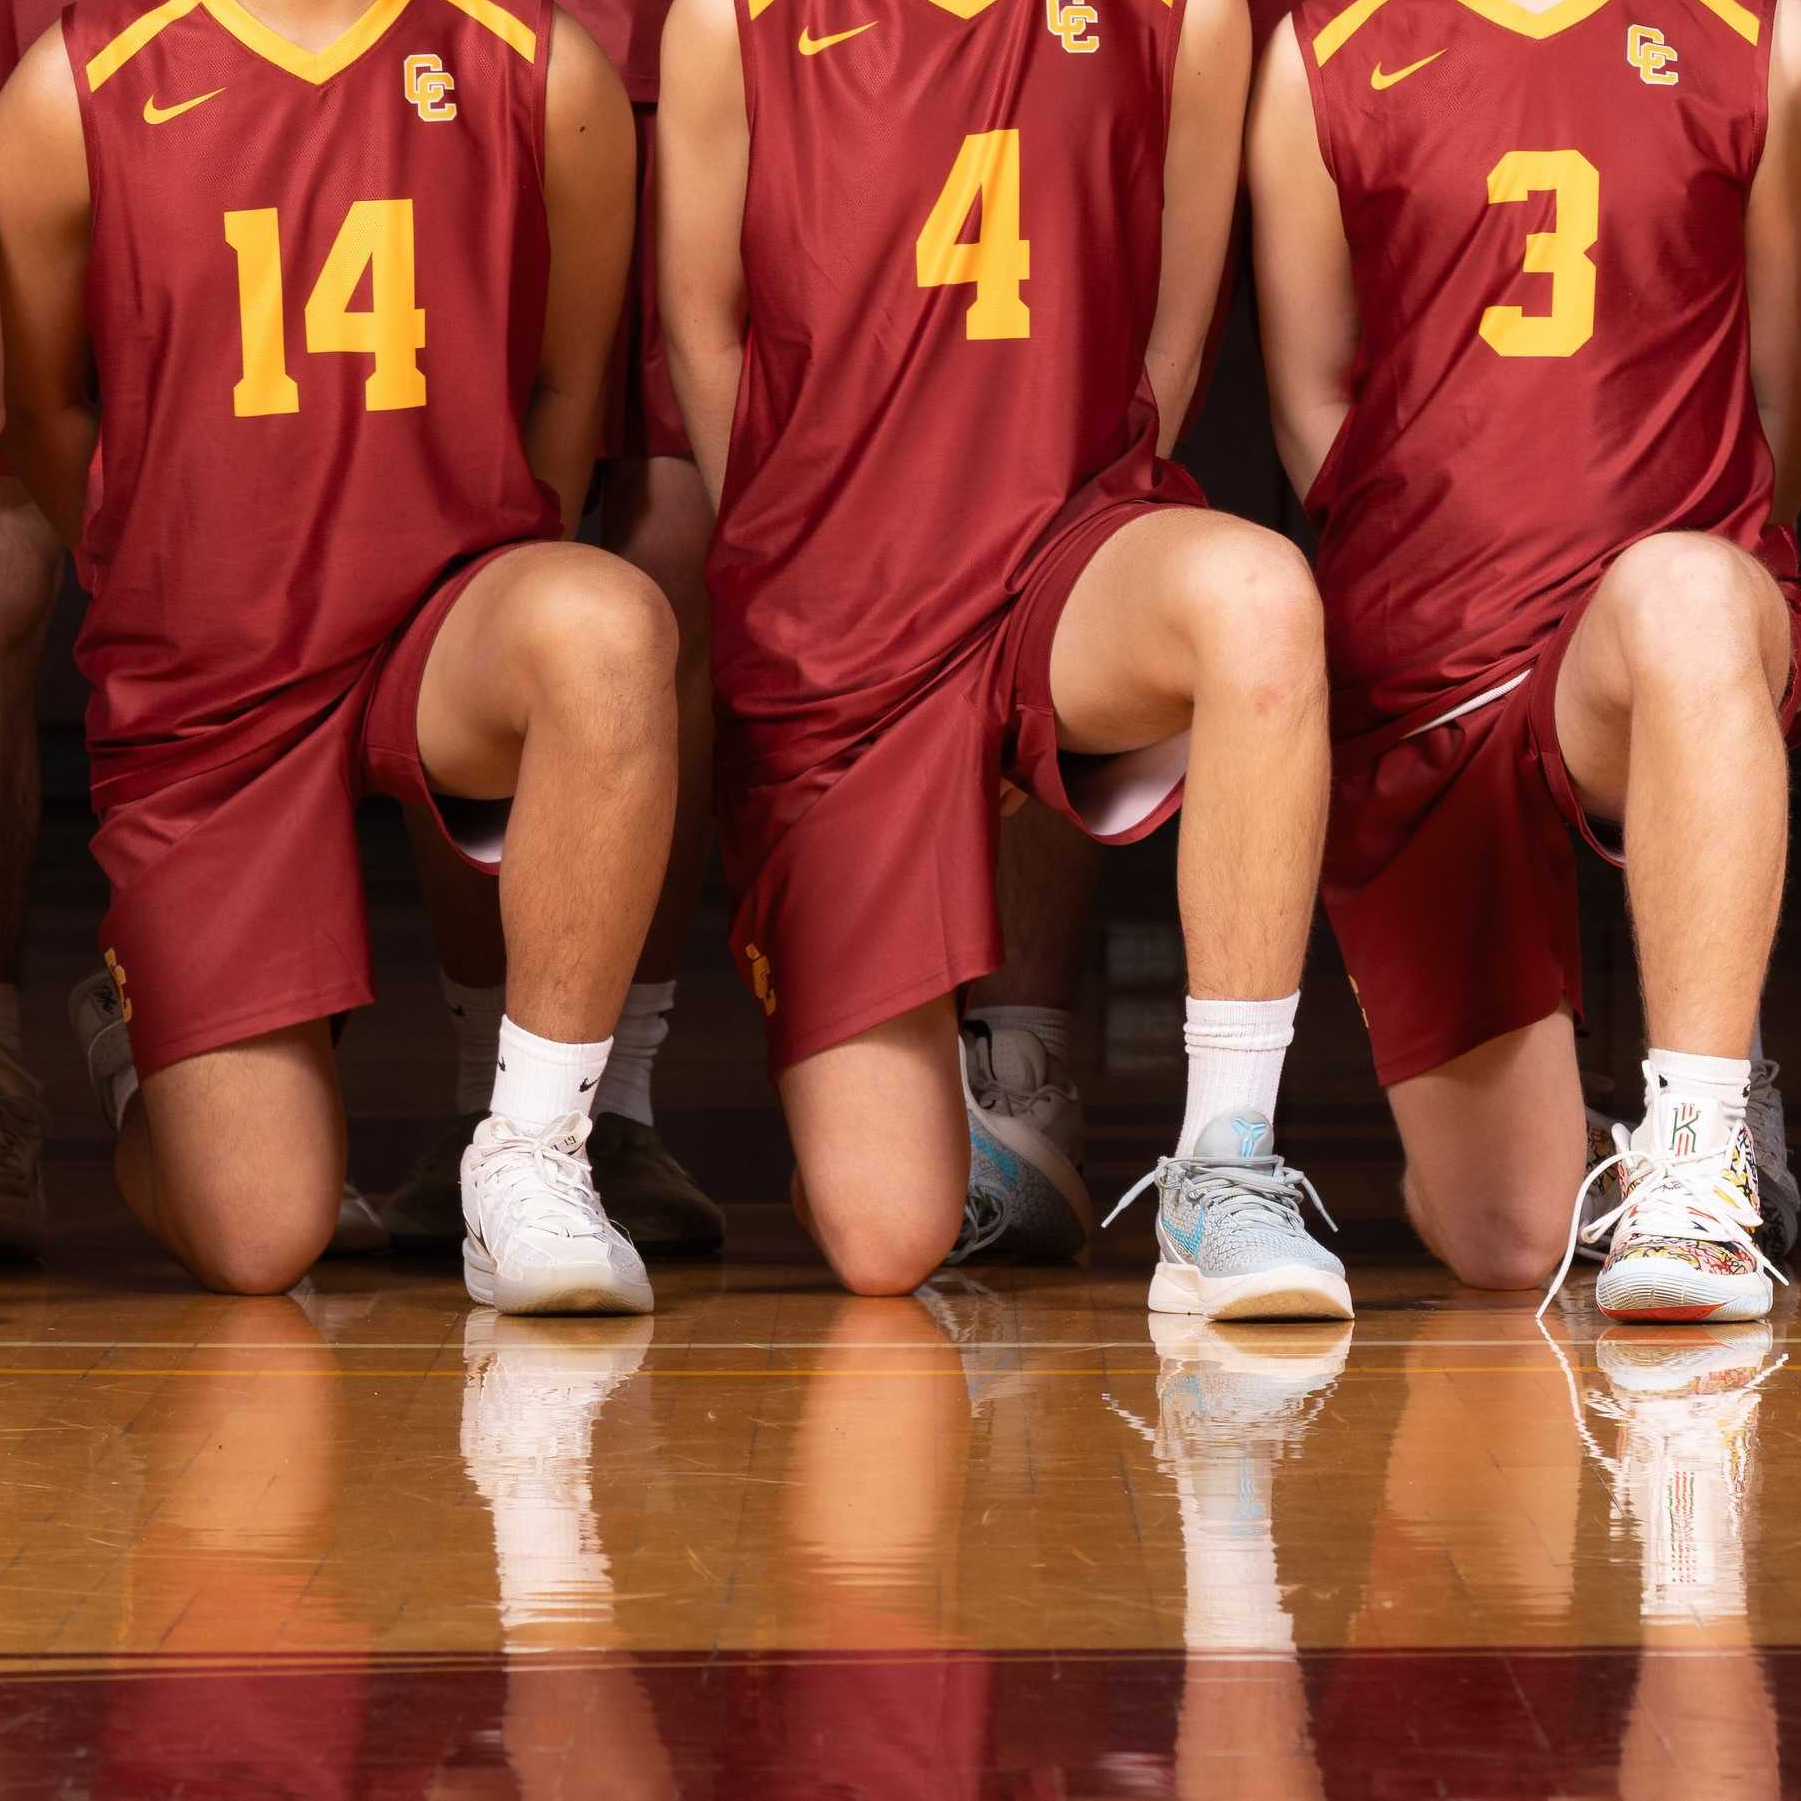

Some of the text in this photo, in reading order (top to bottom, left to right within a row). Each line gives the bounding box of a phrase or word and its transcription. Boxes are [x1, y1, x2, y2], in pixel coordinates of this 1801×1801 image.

[223, 197, 428, 419] 14
[915, 127, 1032, 341] 4
[1477, 149, 1601, 359] 3
